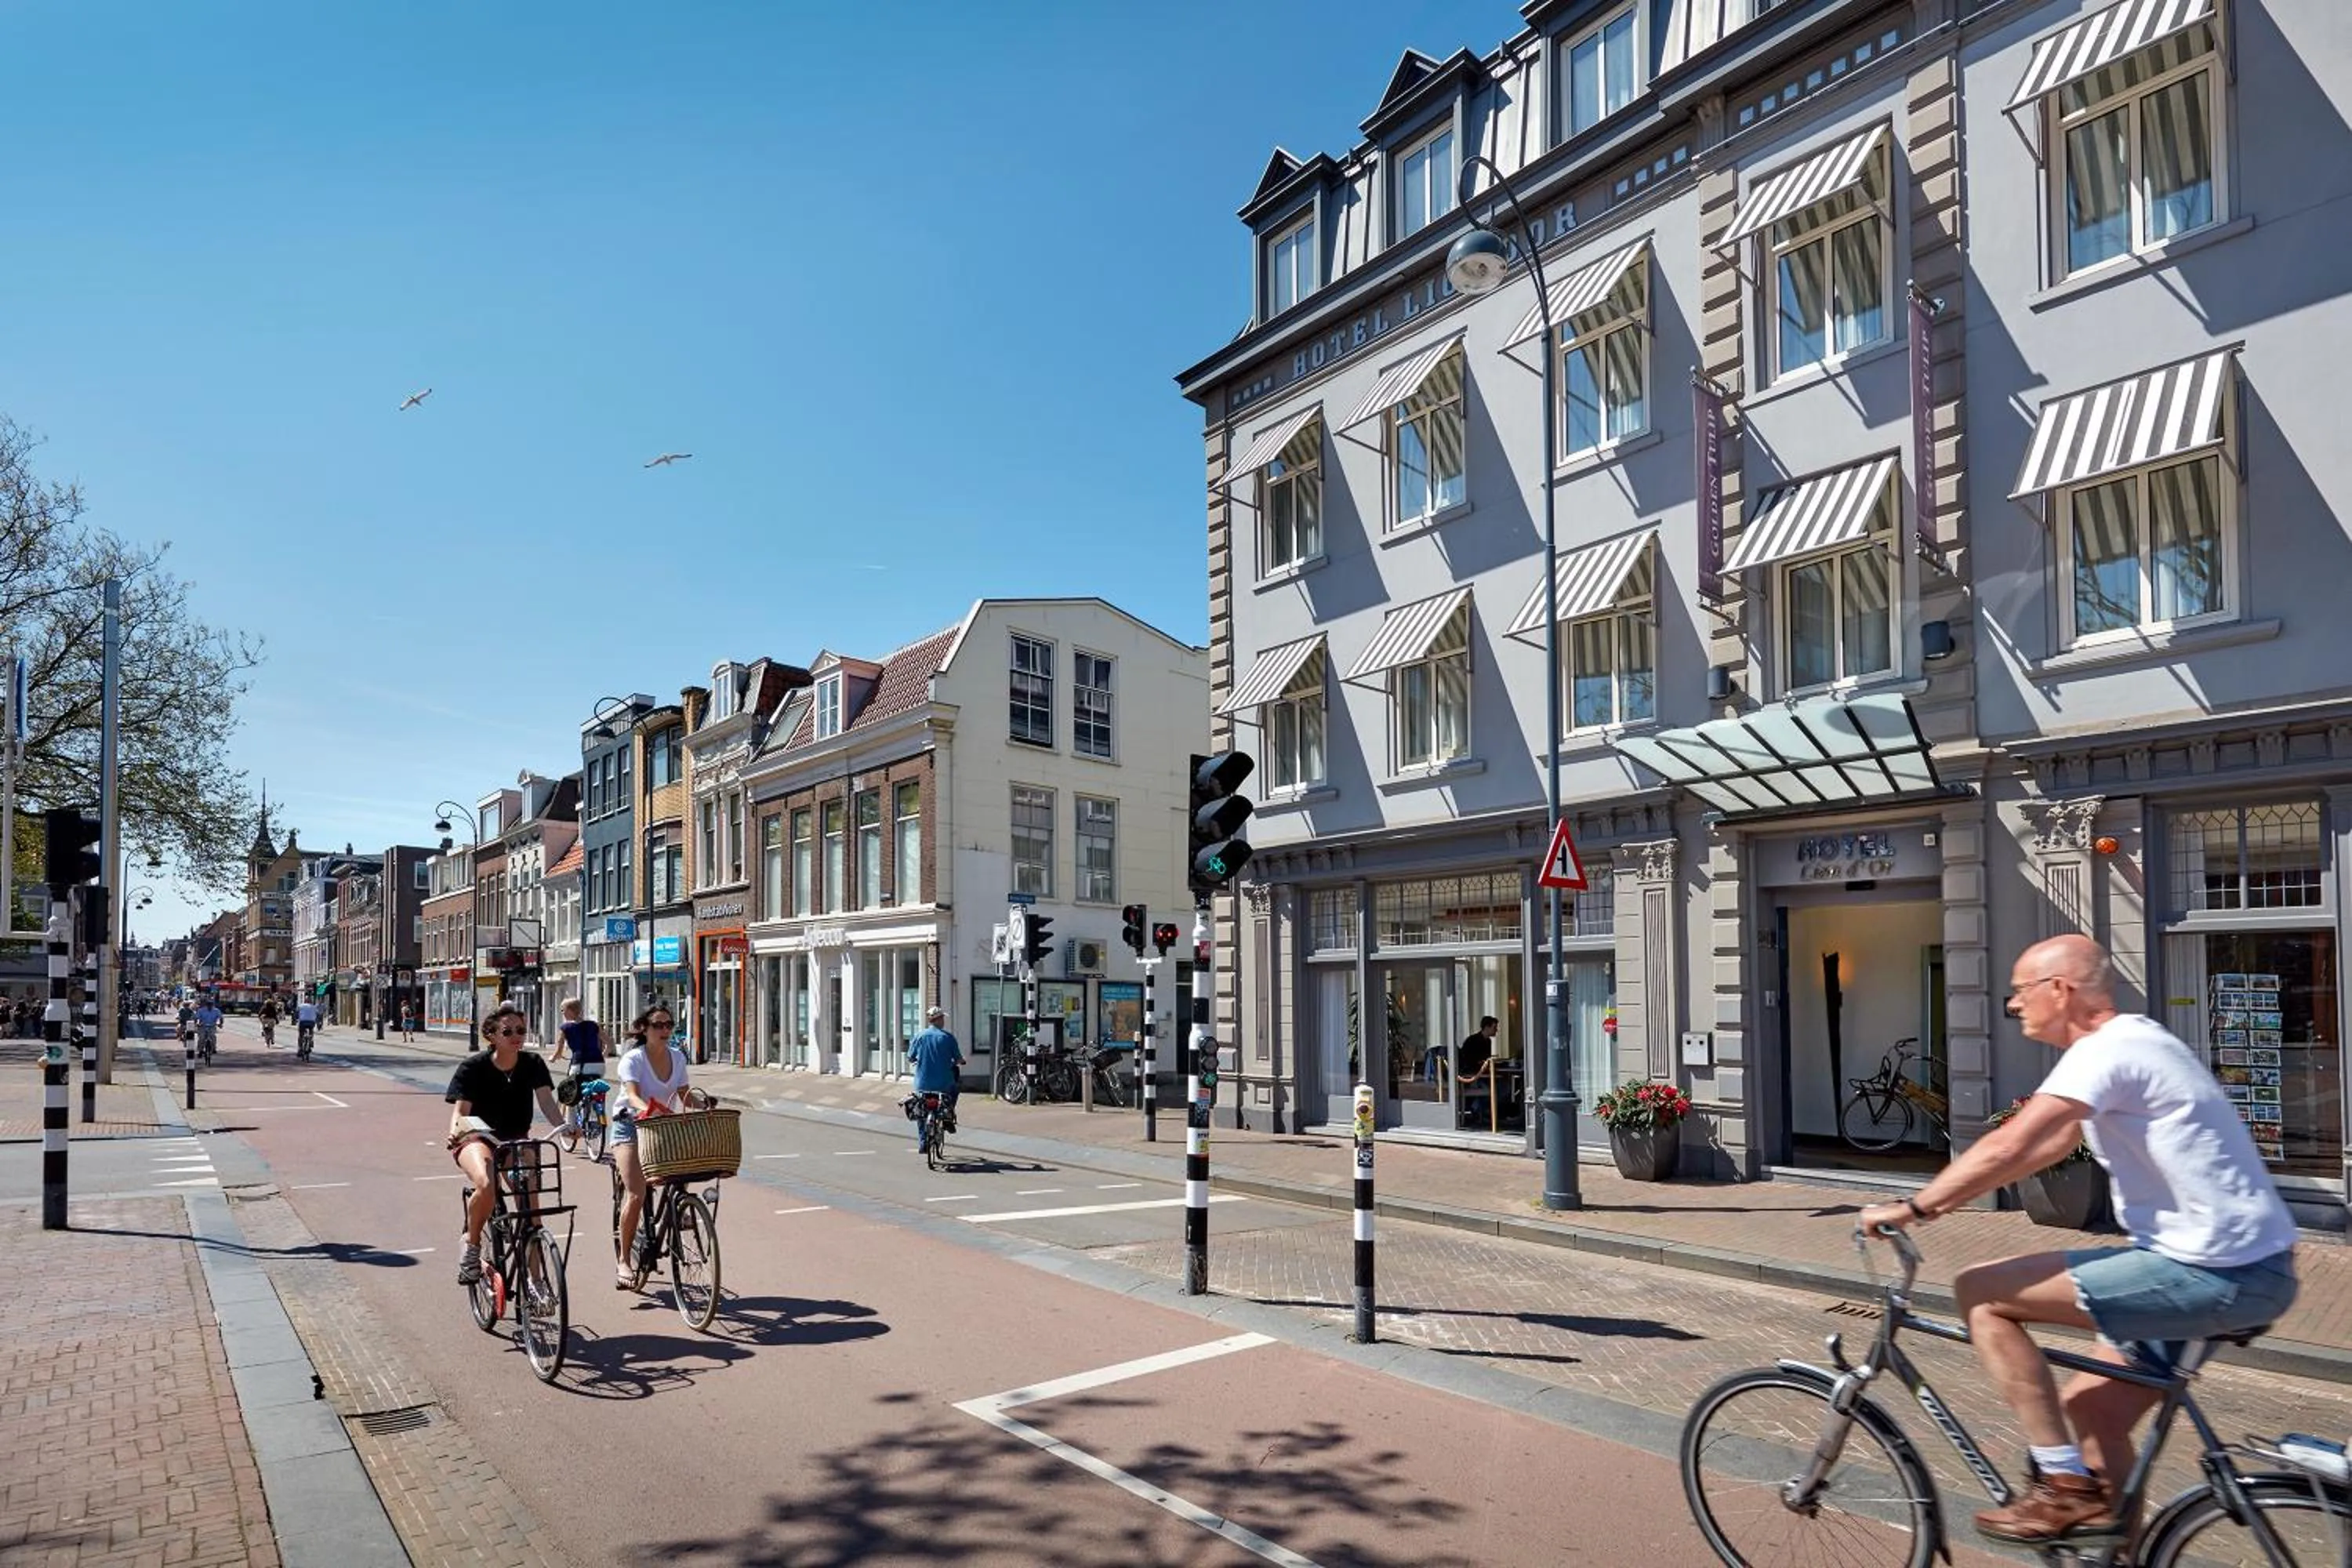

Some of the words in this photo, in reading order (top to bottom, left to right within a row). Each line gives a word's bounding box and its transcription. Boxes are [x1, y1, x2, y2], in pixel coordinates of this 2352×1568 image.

[1294, 307, 1388, 377] HOTEL
[1707, 408, 1717, 468] TULIP
[1710, 474, 1719, 557] GOLDEN
[1798, 833, 1896, 861] HOTEL
